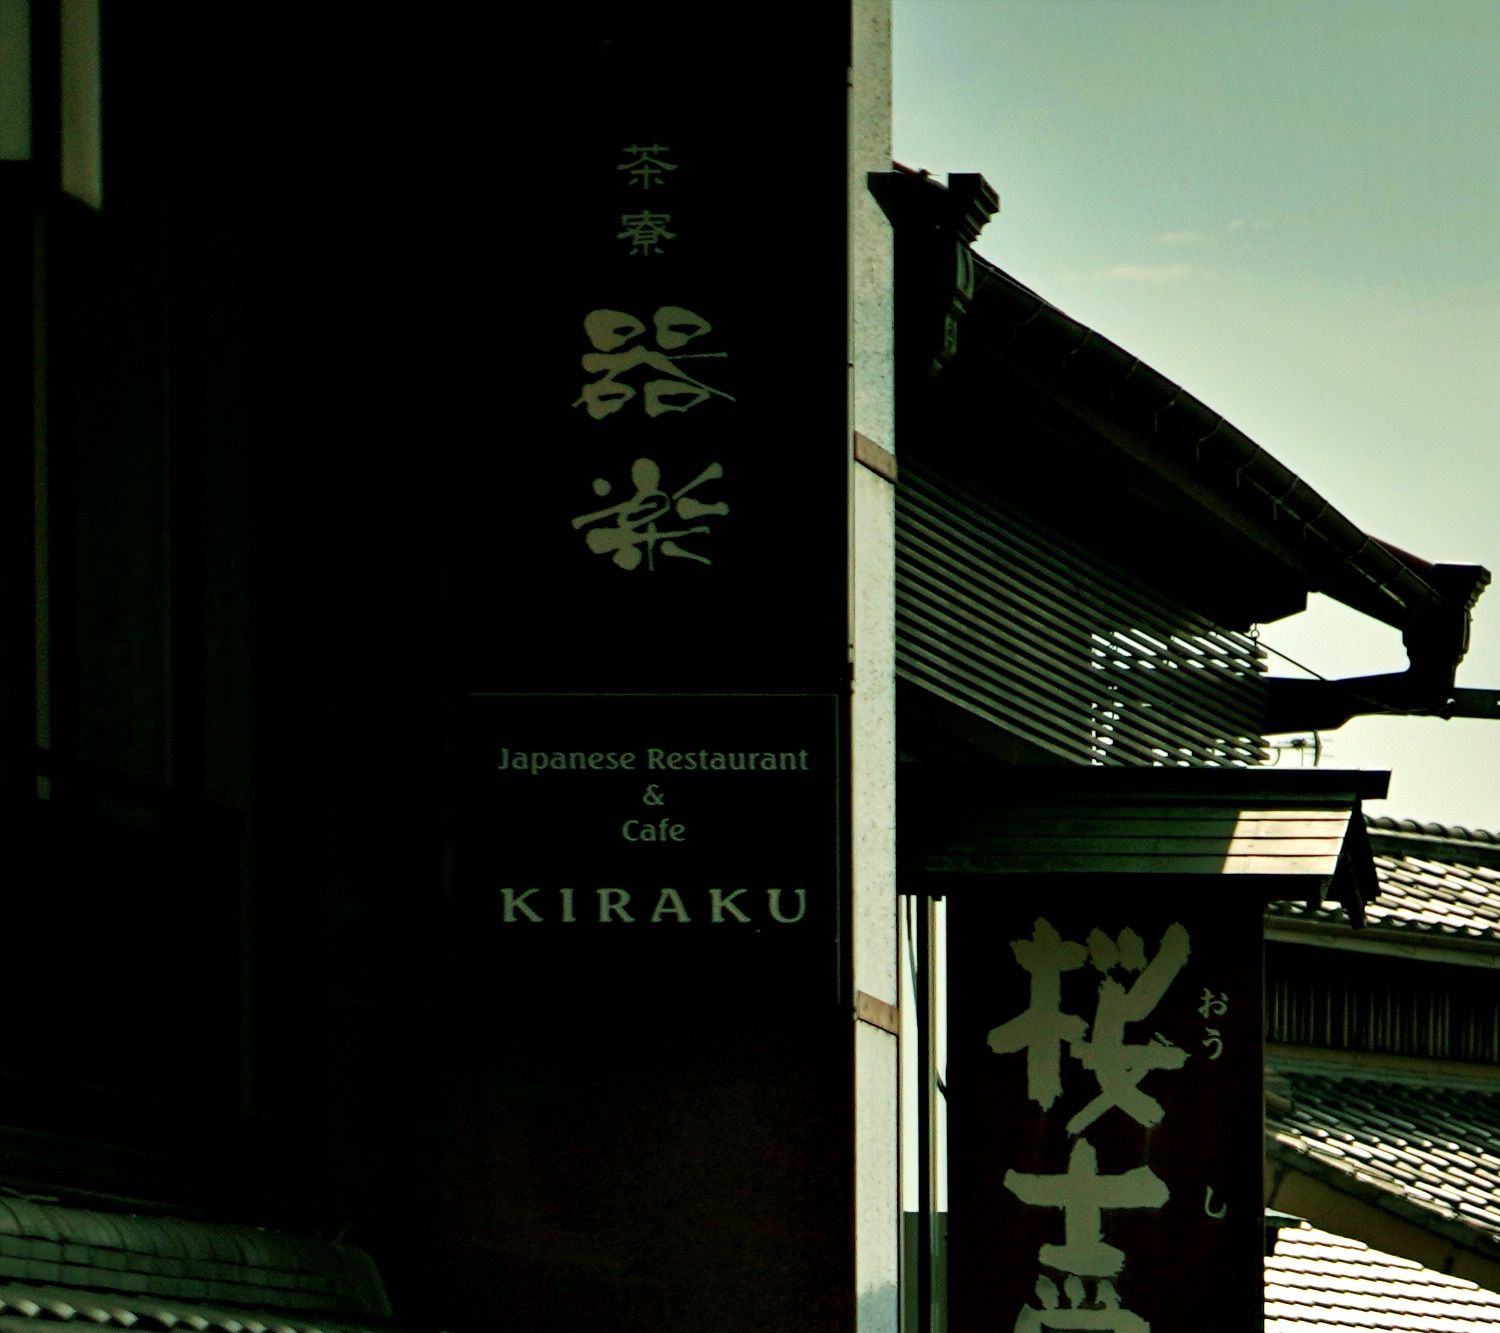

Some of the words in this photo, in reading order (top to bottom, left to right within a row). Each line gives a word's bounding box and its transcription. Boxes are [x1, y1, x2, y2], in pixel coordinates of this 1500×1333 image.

[617, 142, 679, 258] 茶寮
[571, 305, 737, 573] 器楽
[498, 745, 636, 777] Japanese
[647, 745, 810, 773] Restaurant
[641, 784, 666, 809] &
[621, 815, 687, 845] Cafe
[501, 886, 809, 925] KIRAKU
